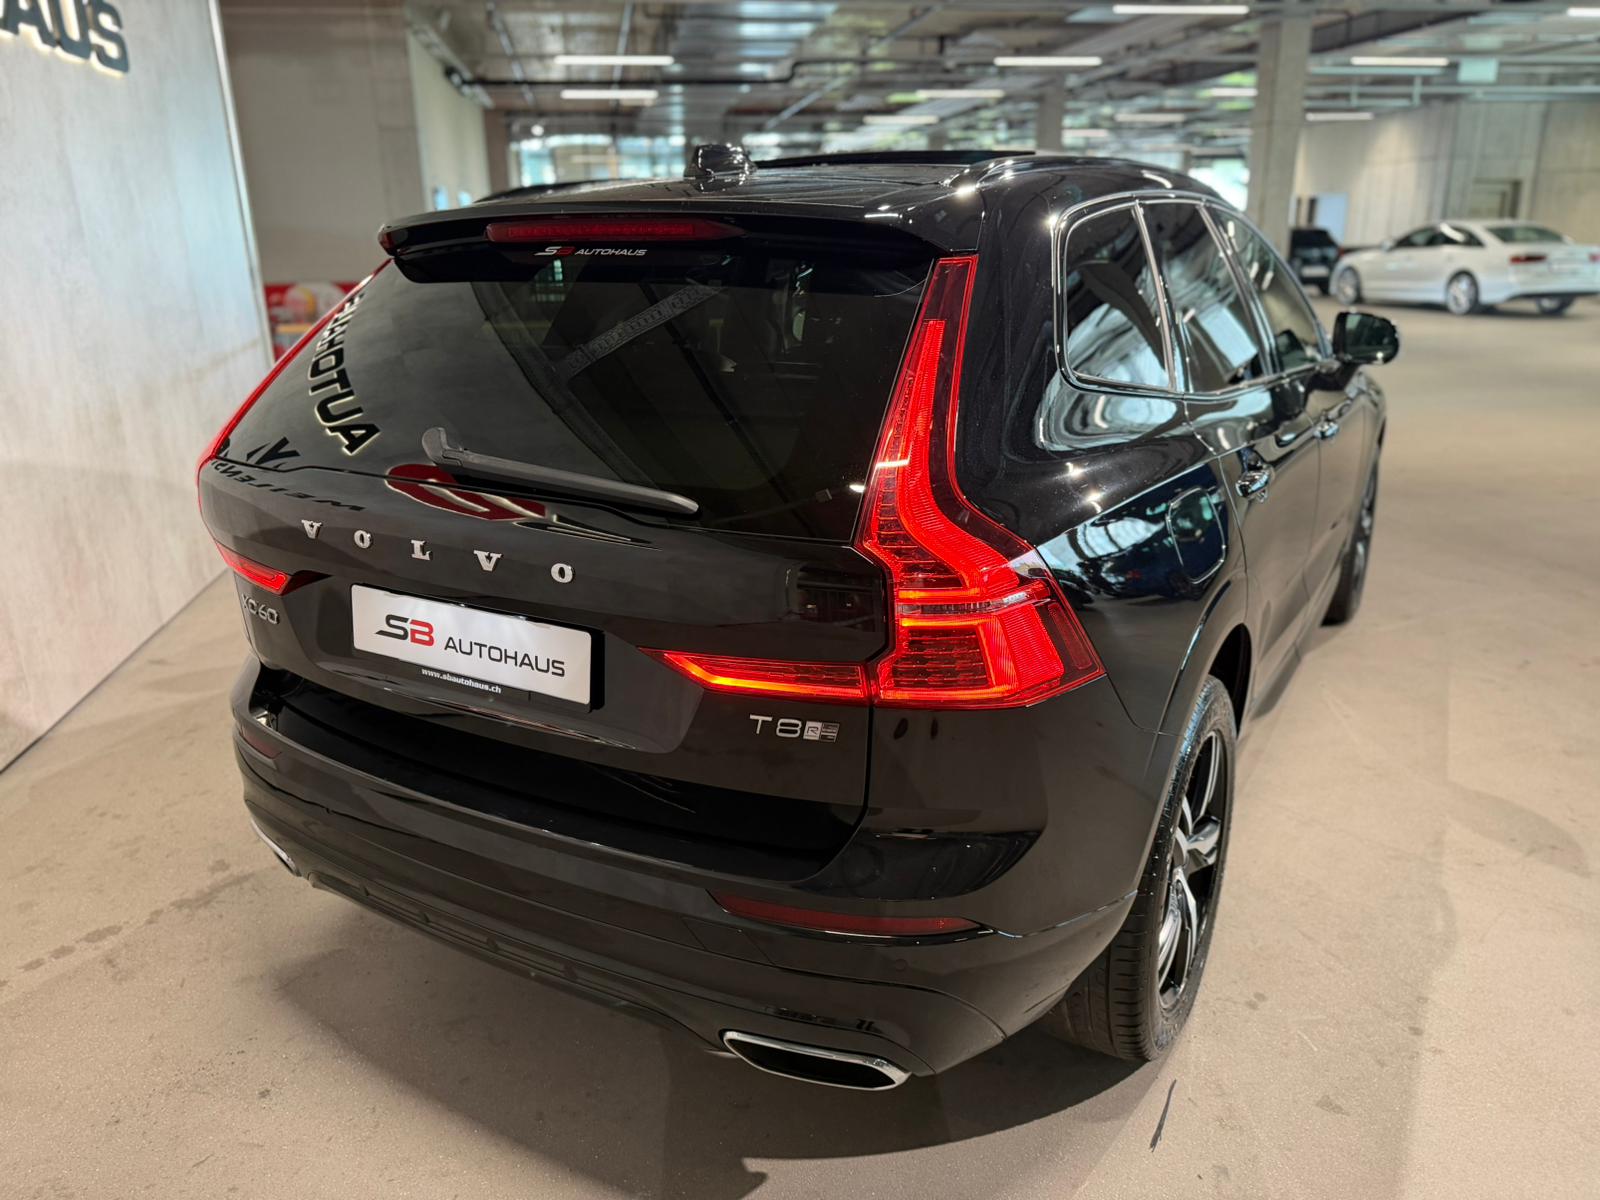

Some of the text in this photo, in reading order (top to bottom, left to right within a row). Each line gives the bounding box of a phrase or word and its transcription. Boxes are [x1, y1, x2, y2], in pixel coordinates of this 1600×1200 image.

[574, 248, 648, 257] AUTOHAUS
[301, 519, 575, 584] VOLVO
[241, 593, 279, 625] XC60
[375, 614, 566, 678] SB AUTOHAUS
[421, 667, 502, 694] www.sbautohaus.ch
[749, 714, 802, 738] T8
